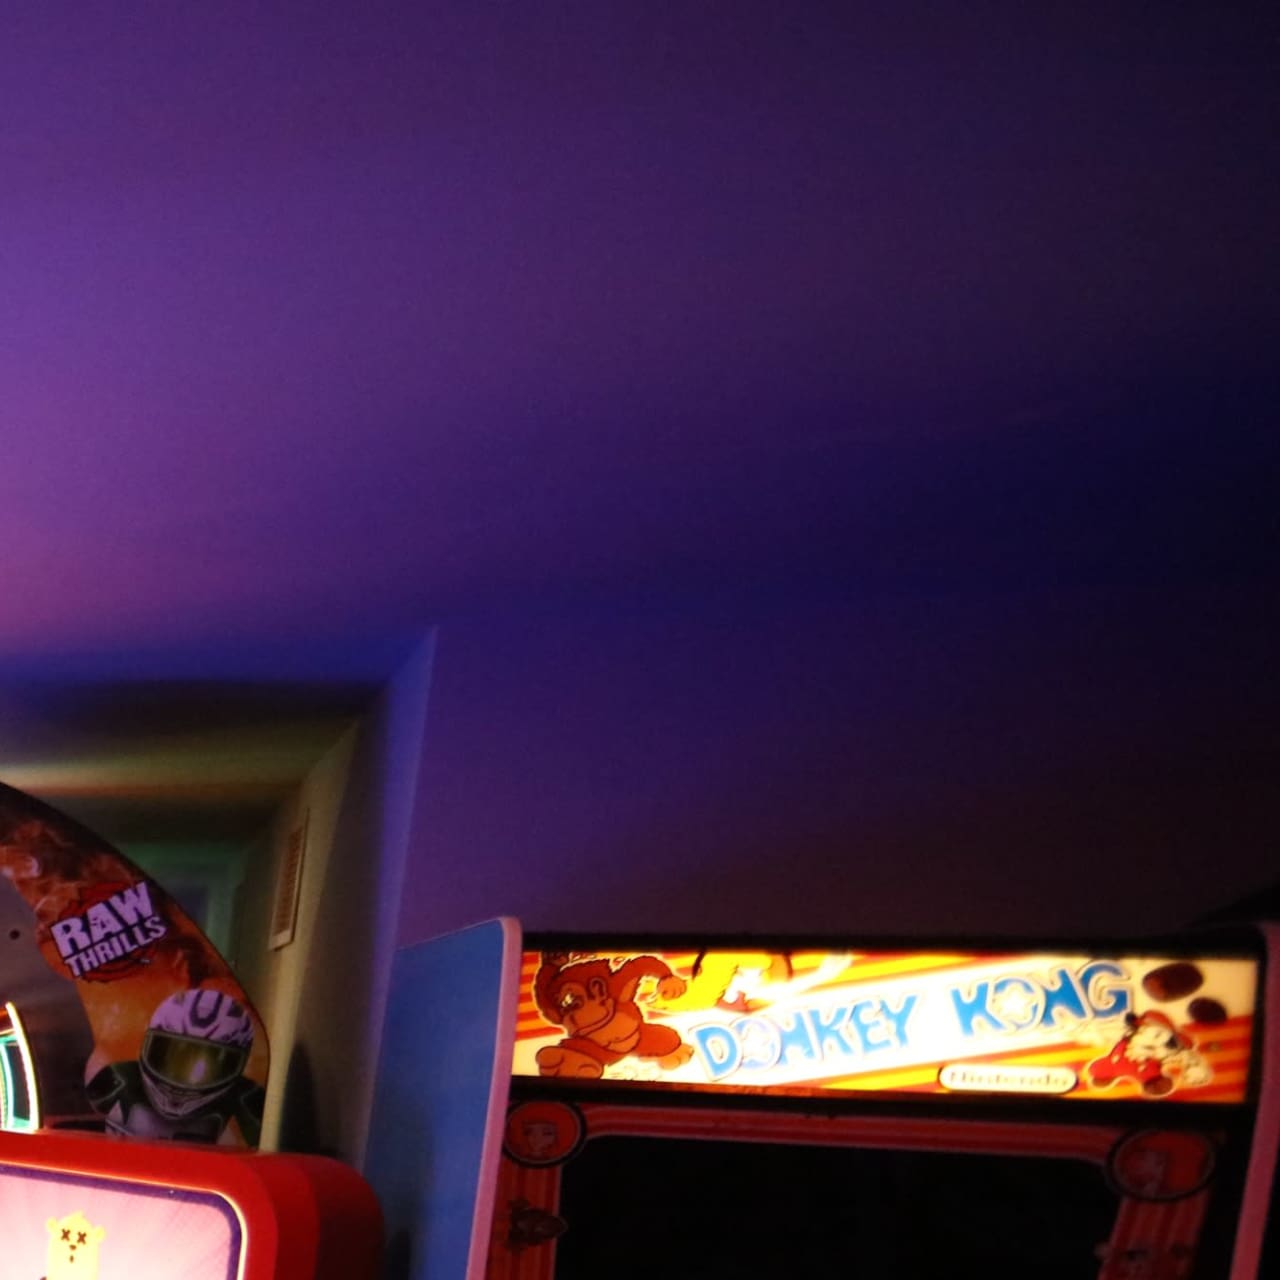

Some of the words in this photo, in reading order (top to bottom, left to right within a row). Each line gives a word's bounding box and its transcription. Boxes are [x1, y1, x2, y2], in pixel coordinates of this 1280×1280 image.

[51, 882, 153, 958] RAW
[64, 916, 167, 977] THRILLS
[692, 994, 919, 1079] DONKEY
[950, 961, 1132, 1037] KONG
